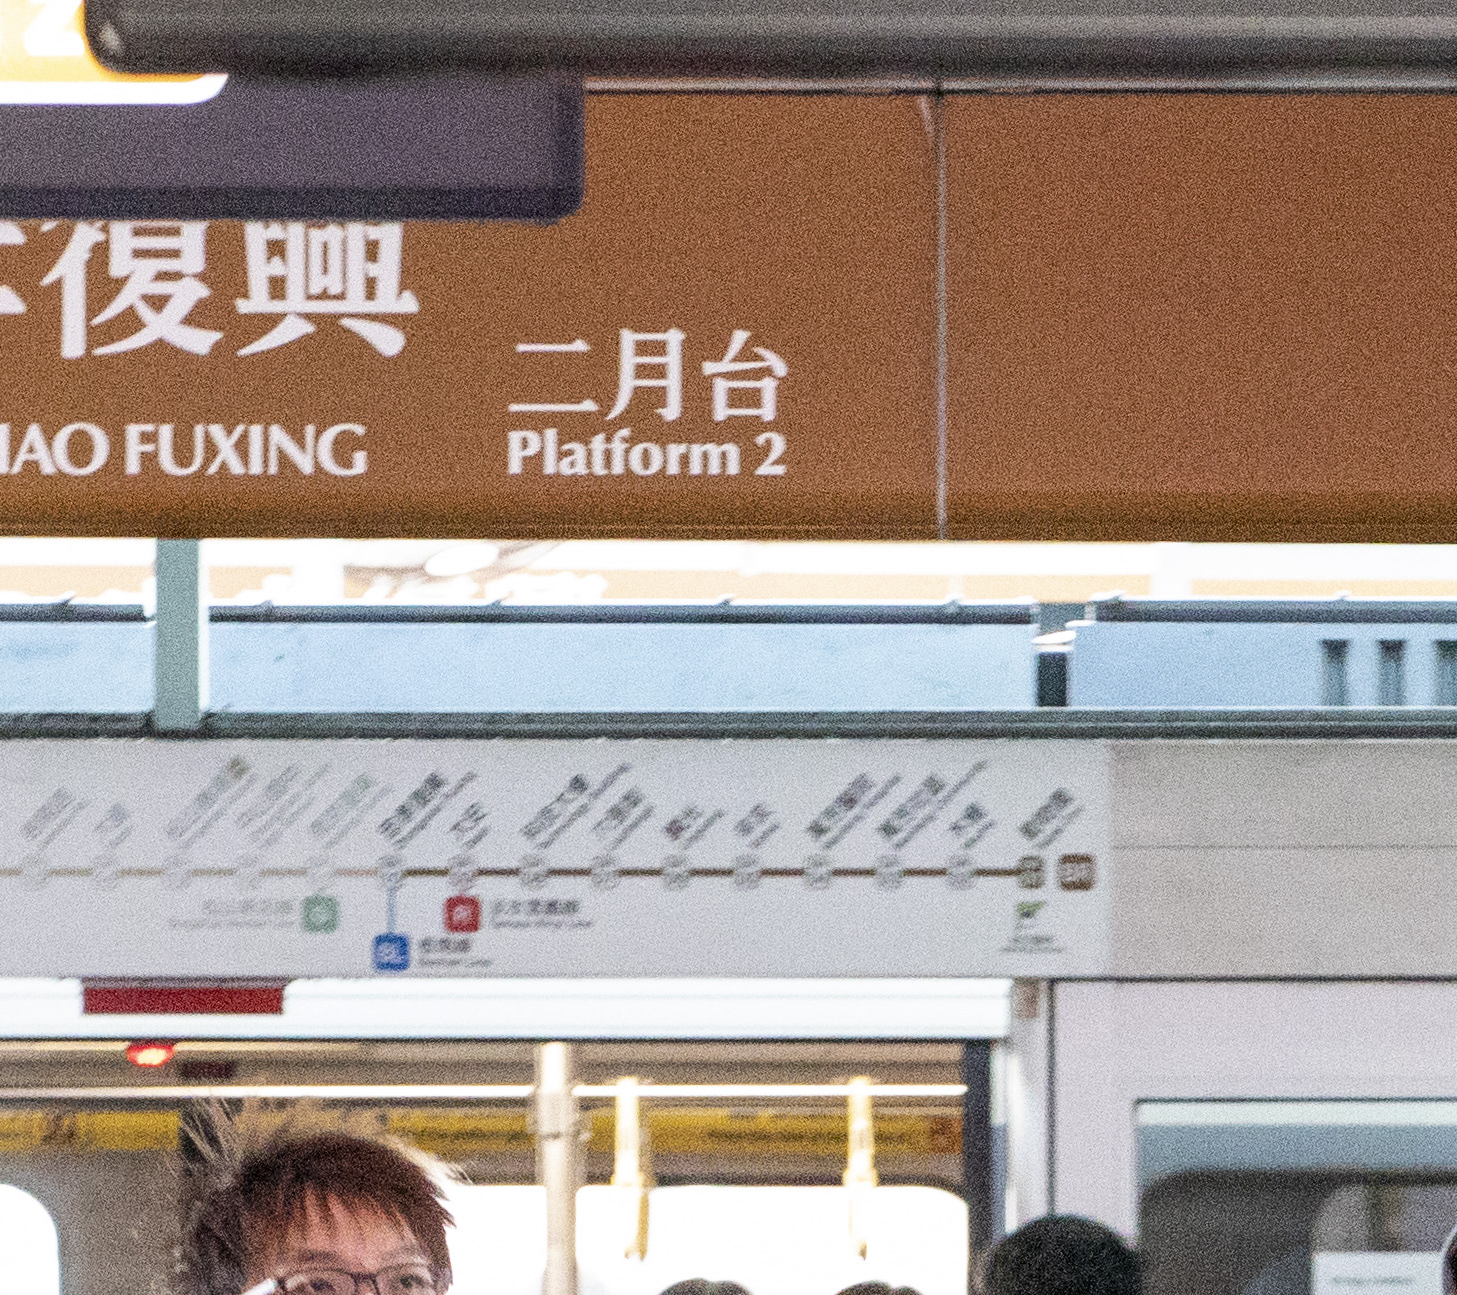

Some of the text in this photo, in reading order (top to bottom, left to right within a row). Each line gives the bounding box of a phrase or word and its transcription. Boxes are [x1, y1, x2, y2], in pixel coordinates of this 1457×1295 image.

[507, 328, 789, 422] 二月台
[125, 422, 369, 477] FUXING
[506, 427, 788, 476] Platform 2
